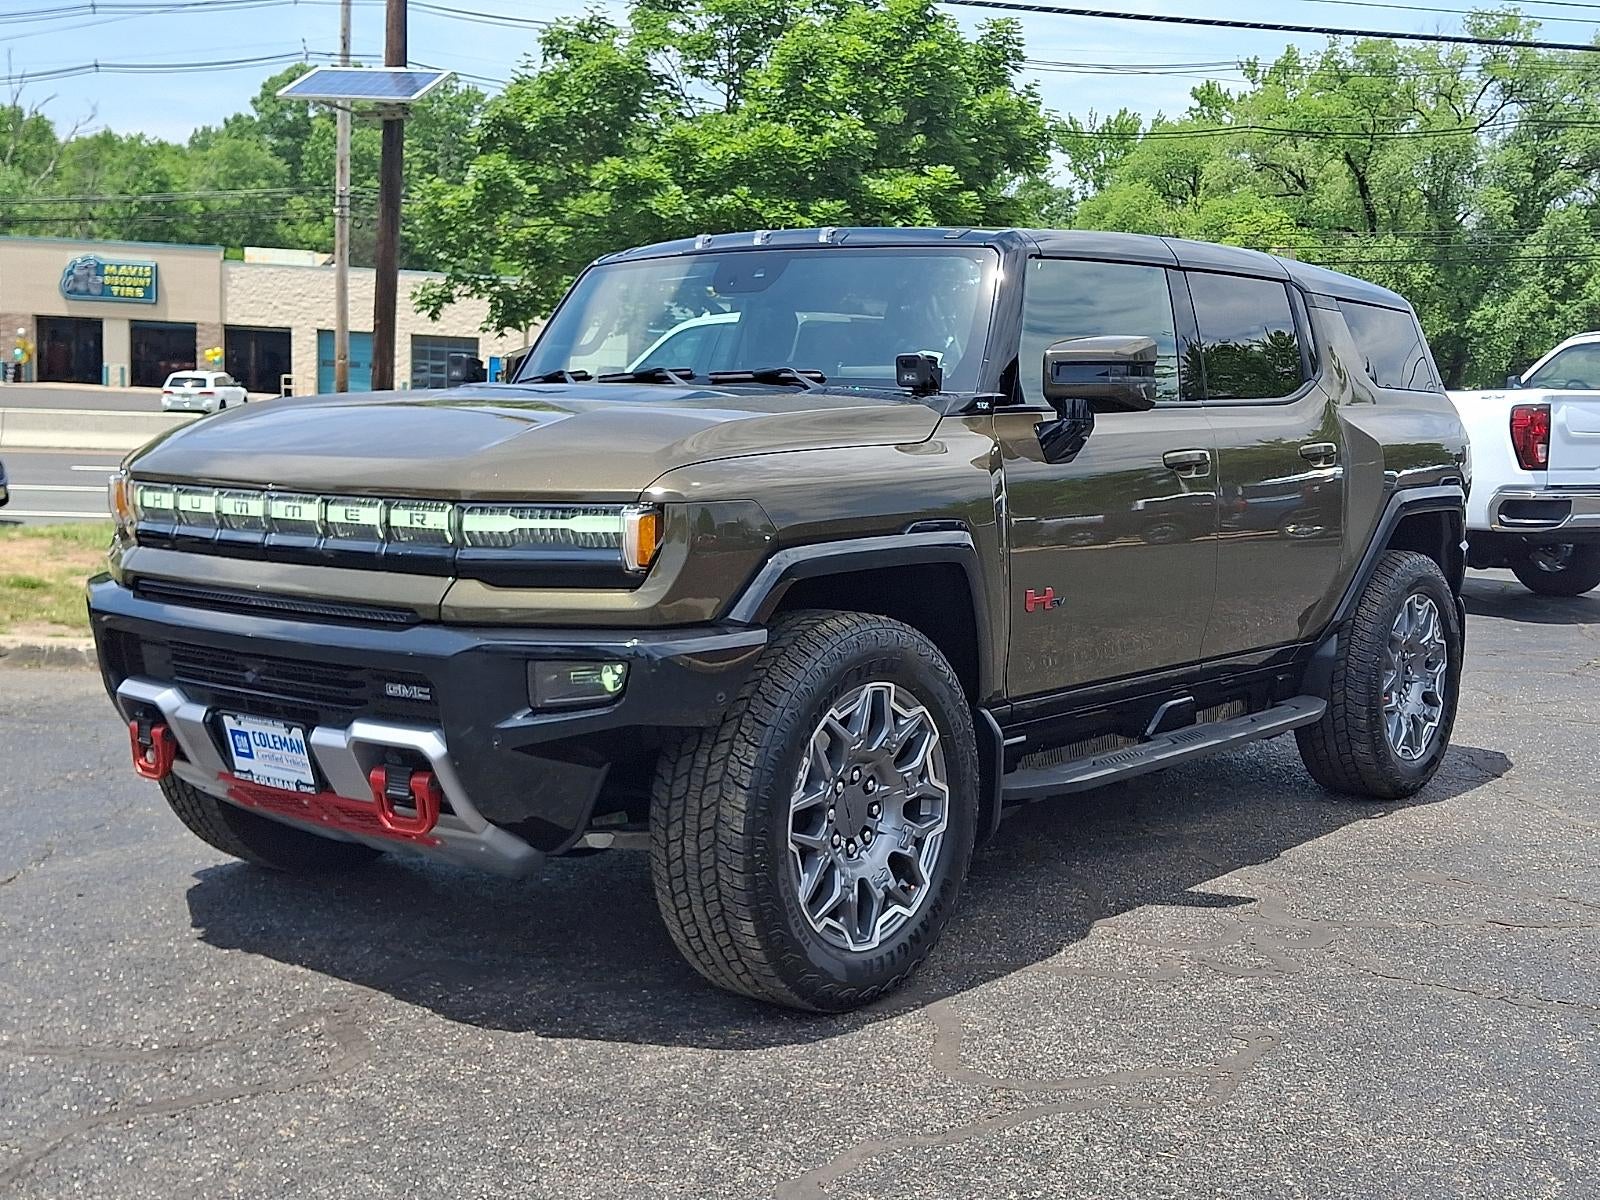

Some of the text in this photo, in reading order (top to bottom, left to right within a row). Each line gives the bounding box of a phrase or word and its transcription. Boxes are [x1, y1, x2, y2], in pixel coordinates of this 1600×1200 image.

[104, 264, 152, 277] MAVIS
[104, 275, 152, 287] DISCOUNT
[111, 286, 145, 297] TIRE
[153, 494, 428, 526] HUMMER
[385, 682, 431, 701] GMC
[252, 730, 306, 756] COLEMAN
